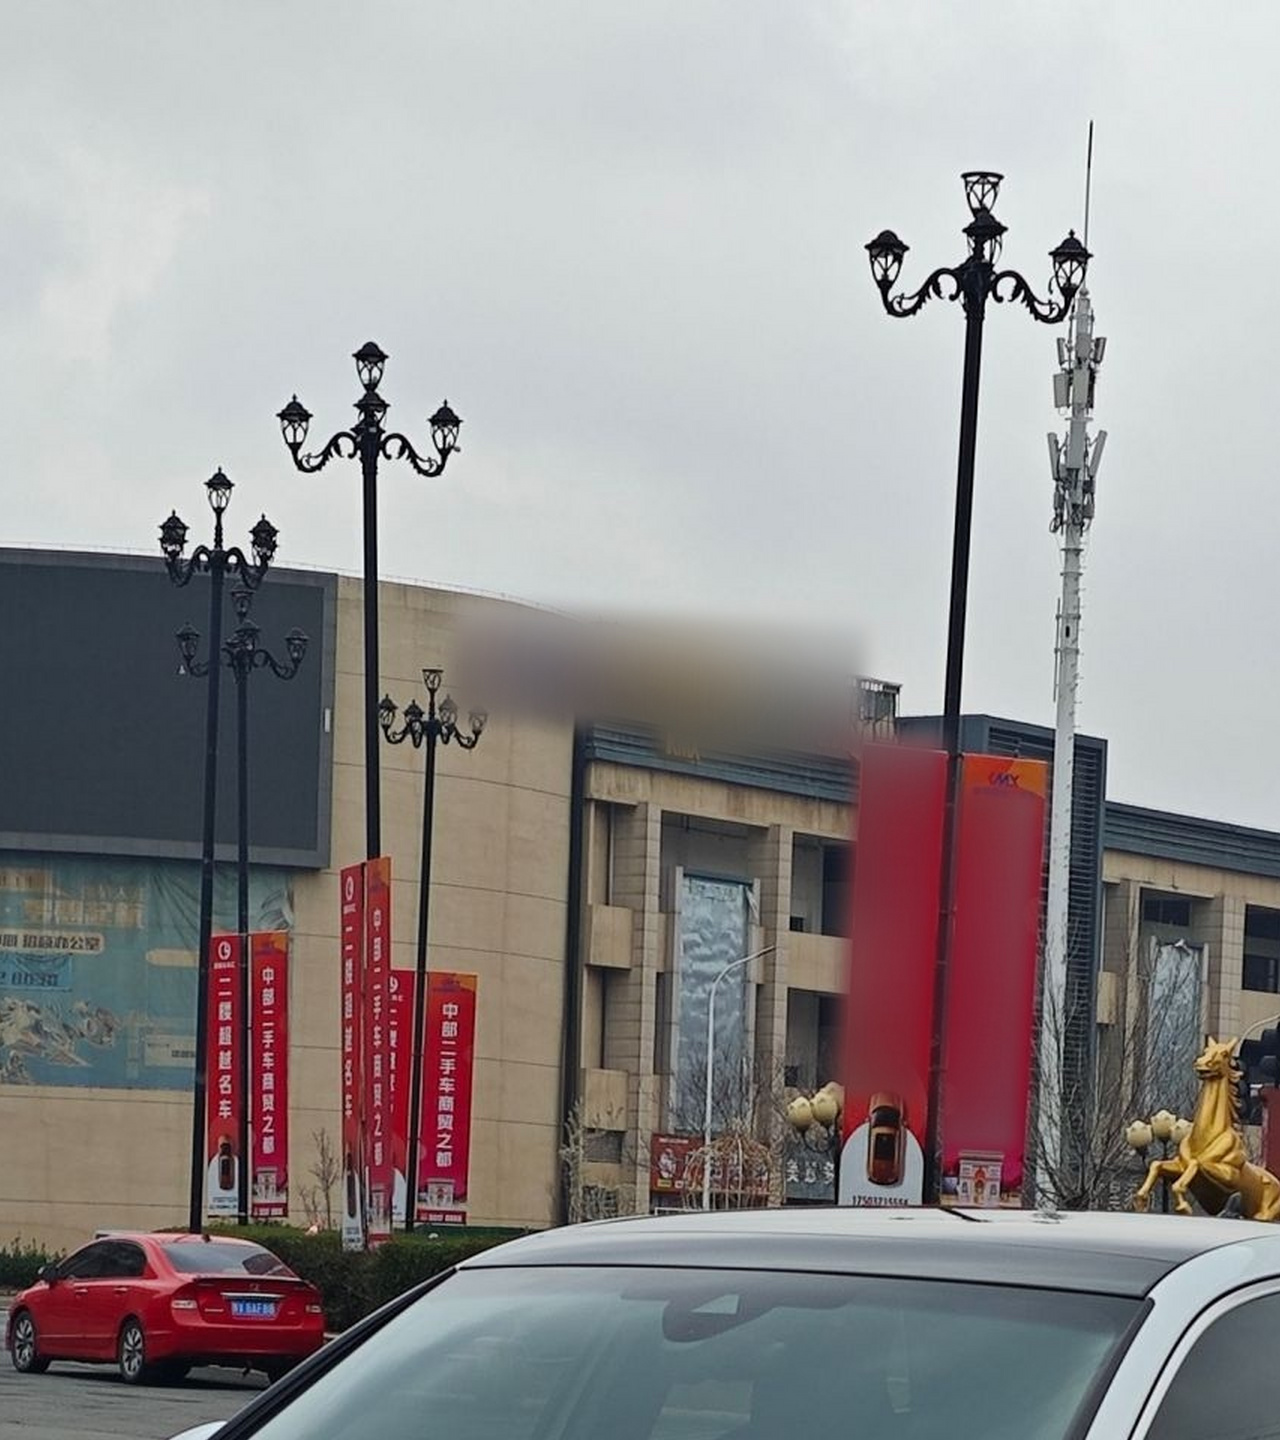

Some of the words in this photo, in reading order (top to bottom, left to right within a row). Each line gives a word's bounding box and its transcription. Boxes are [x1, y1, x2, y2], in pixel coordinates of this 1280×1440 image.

[435, 1003, 459, 1168] 中部二手车商贸之都
